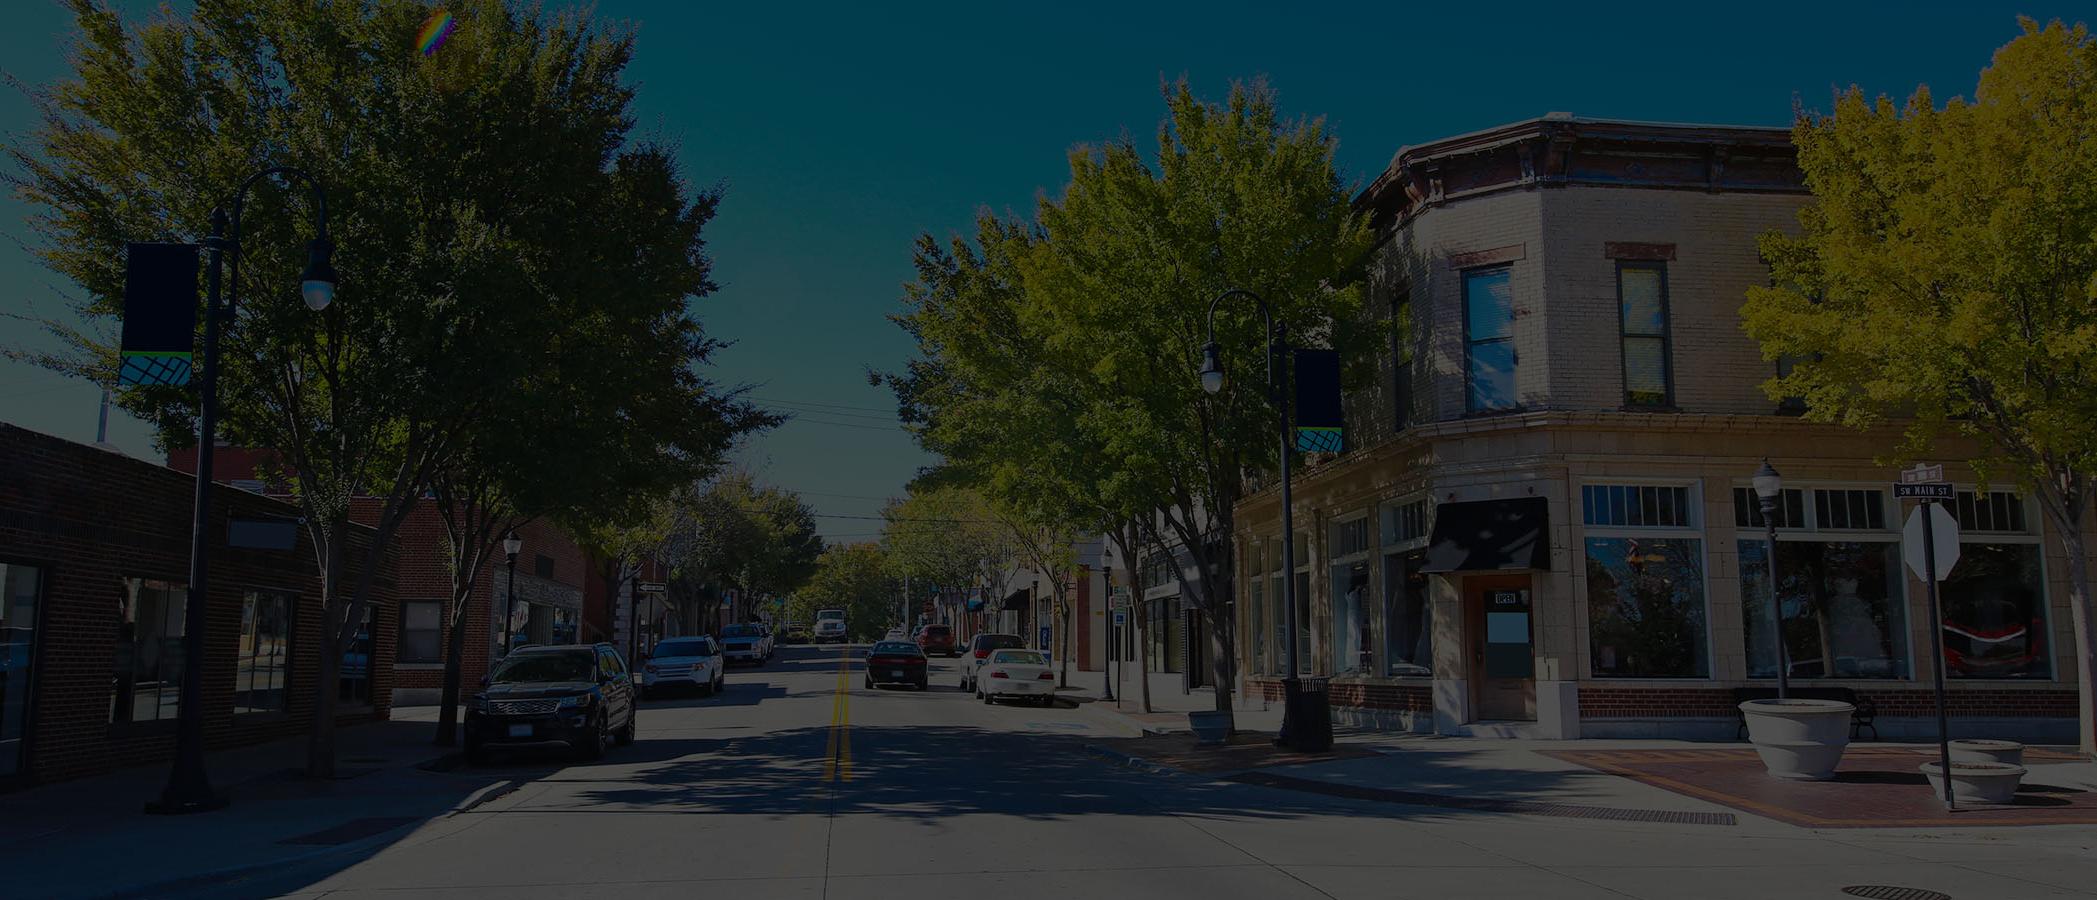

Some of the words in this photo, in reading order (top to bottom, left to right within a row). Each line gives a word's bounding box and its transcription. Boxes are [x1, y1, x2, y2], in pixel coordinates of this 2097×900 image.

[1900, 487, 1911, 495] SW
[1914, 485, 1935, 495] MAIN
[1938, 487, 1948, 495] ST
[1497, 594, 1514, 603] OPEN
